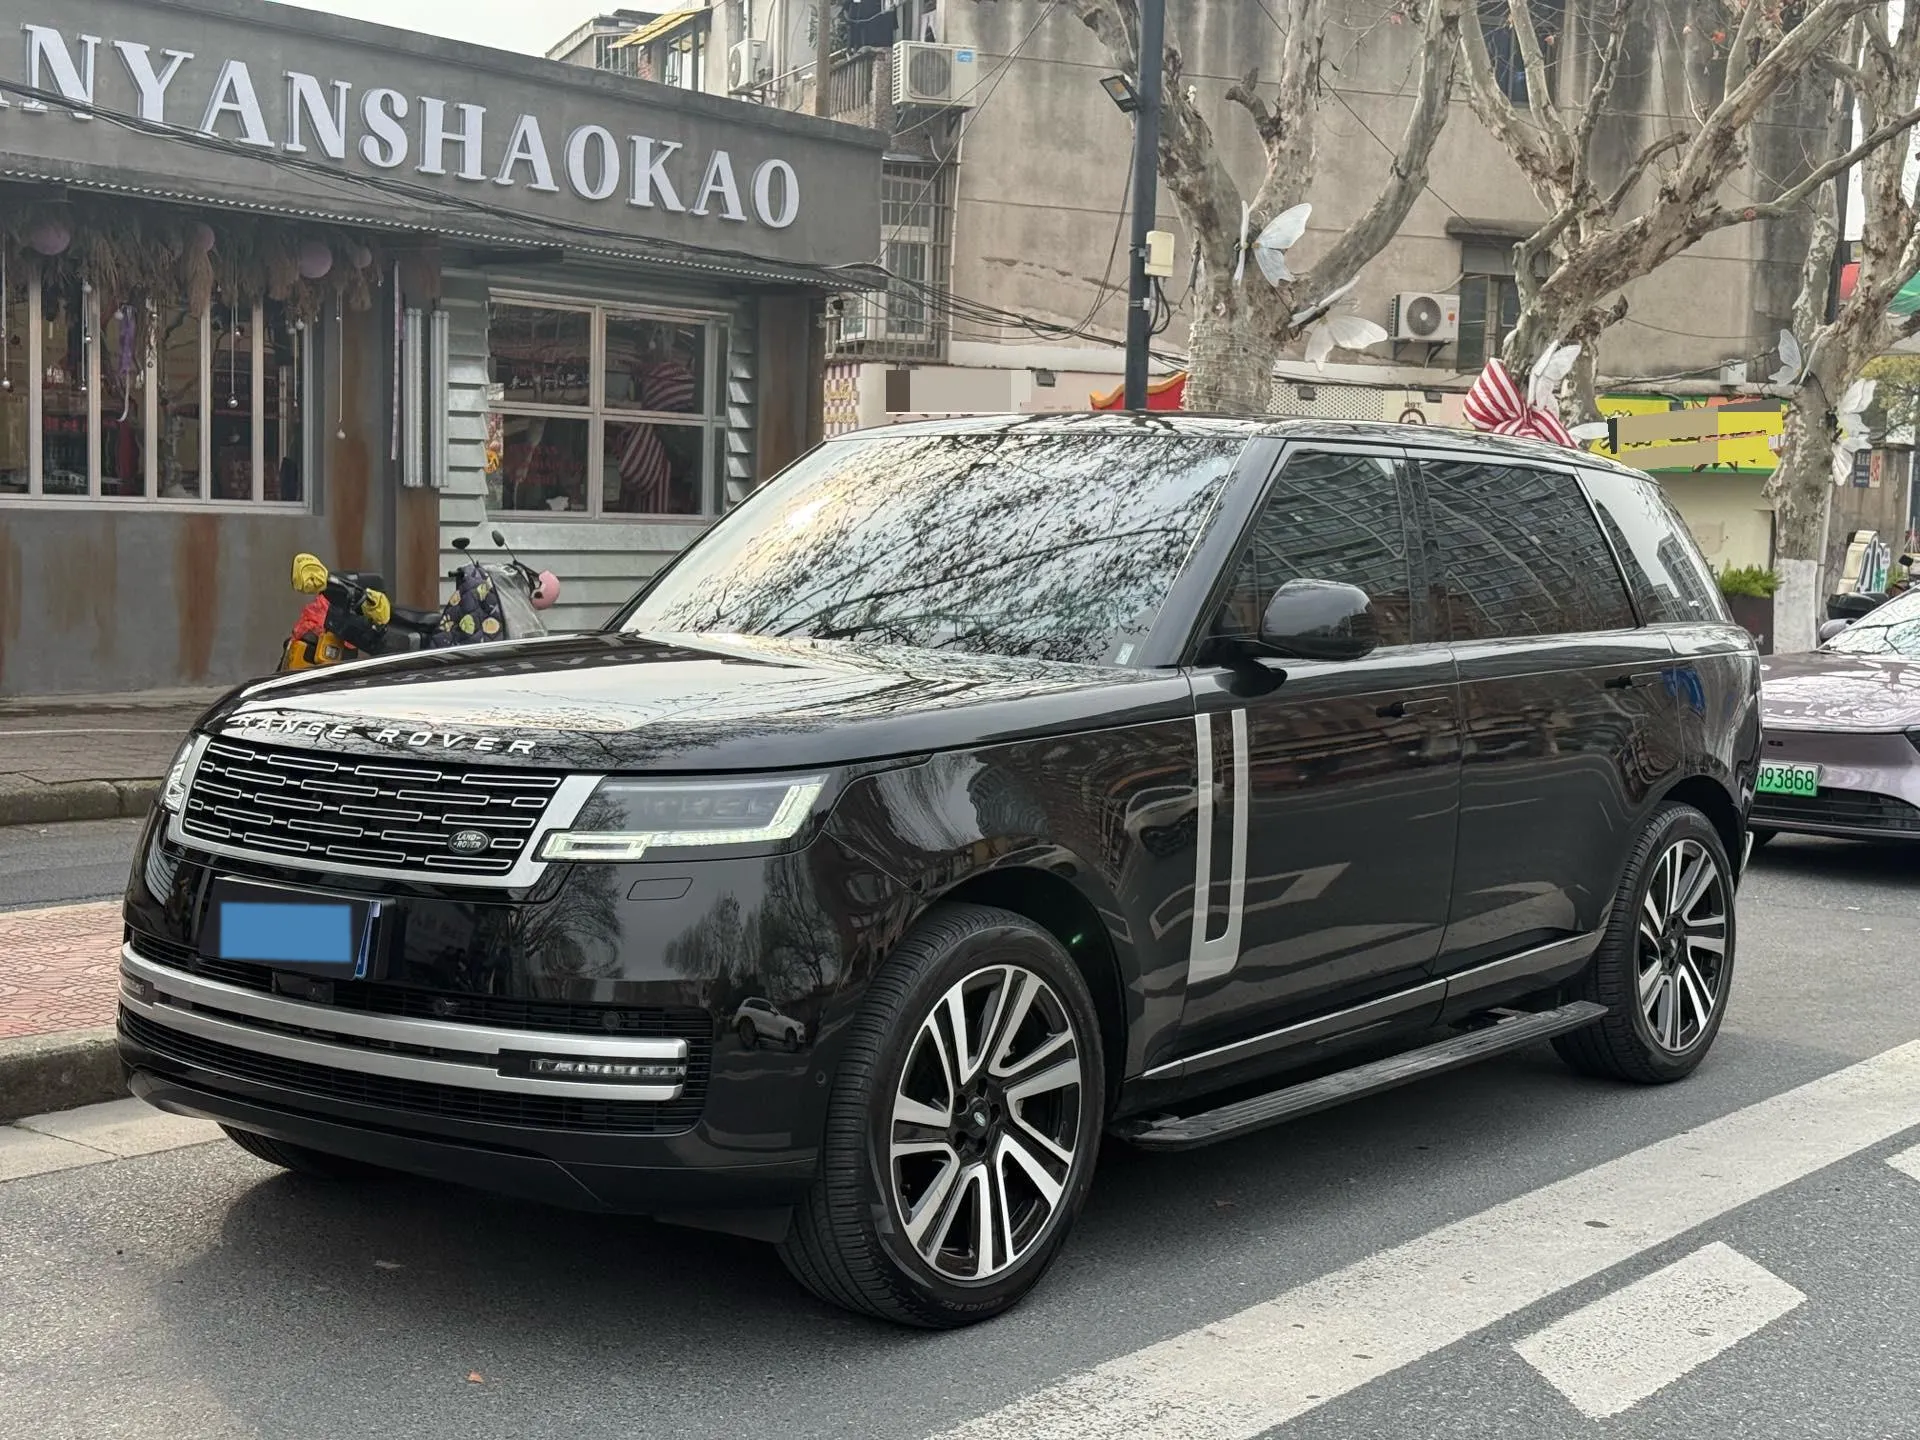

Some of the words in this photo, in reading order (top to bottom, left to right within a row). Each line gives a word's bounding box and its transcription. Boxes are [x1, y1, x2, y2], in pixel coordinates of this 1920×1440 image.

[0, 23, 799, 228] NYANSHAOKAO
[238, 716, 353, 739] RANGE
[375, 729, 536, 755] ROVER
